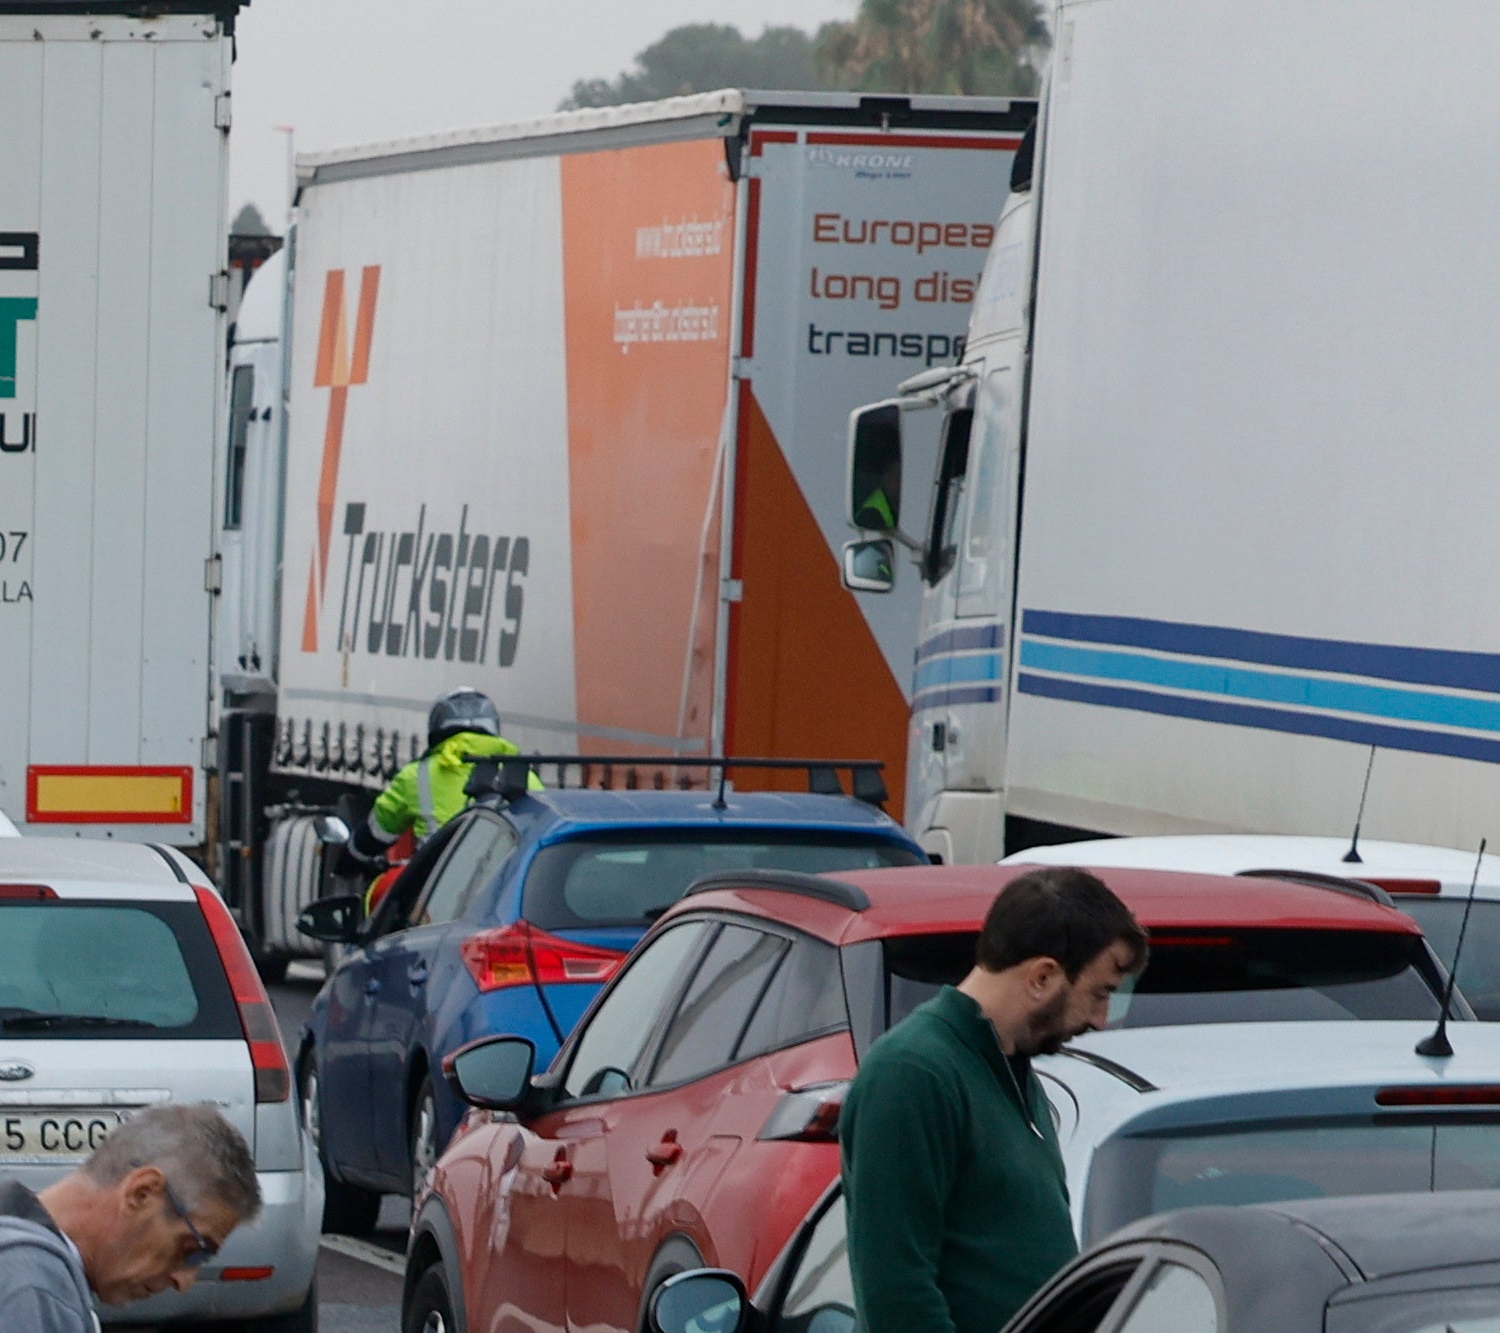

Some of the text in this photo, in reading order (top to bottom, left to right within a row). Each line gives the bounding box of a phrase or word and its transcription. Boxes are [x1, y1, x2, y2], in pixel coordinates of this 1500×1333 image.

[813, 213, 995, 255] Europea
[810, 267, 982, 310] long dis
[337, 501, 530, 668] Trucksters
